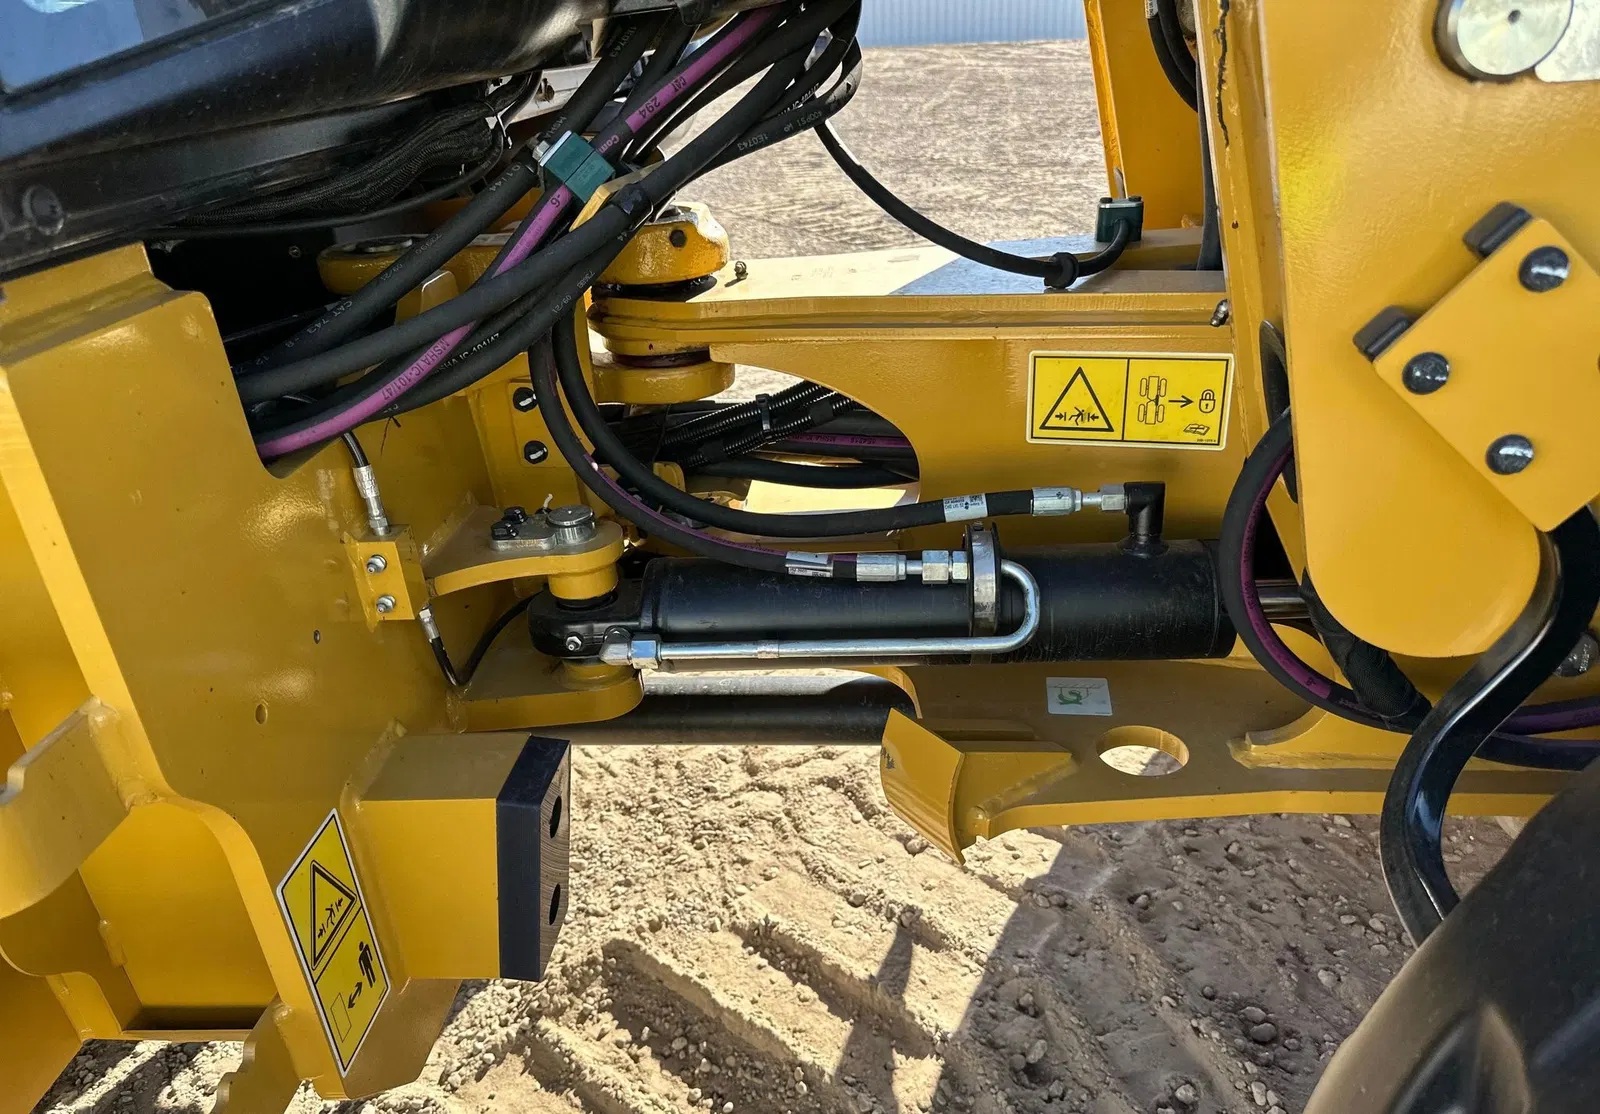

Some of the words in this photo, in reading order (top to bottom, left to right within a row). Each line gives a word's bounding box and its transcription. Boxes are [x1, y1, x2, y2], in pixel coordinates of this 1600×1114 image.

[668, 74, 688, 93] CAT
[634, 95, 661, 119] 294
[736, 132, 769, 151] 1E0743
[549, 192, 564, 208] -6
[330, 298, 355, 318] CAT
[305, 316, 330, 335] 743
[417, 336, 451, 368] MSHA
